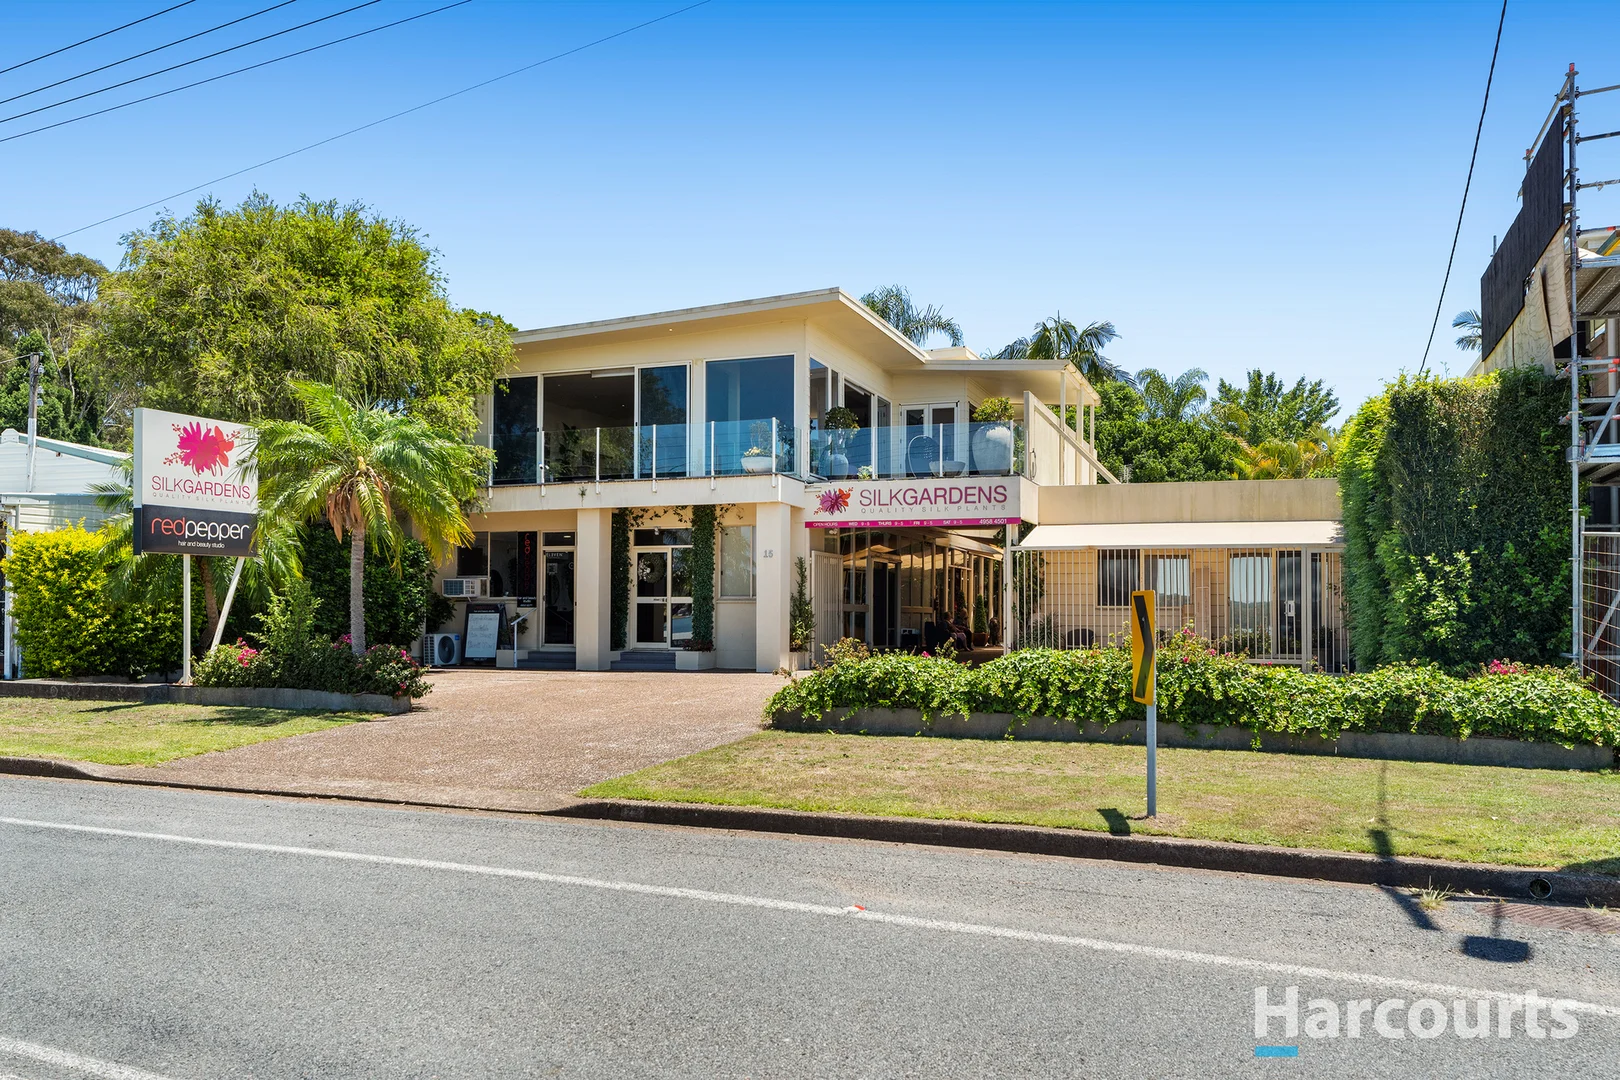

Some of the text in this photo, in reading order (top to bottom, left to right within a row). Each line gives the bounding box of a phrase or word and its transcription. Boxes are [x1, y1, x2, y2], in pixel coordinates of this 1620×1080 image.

[151, 475, 251, 500] SILKGARDENS
[152, 492, 192, 501] QUALITY
[219, 498, 250, 506] PLANTS
[859, 485, 1008, 508] SILKGARDENS
[860, 507, 914, 515] QUALITY
[957, 504, 1007, 512] PLANTS
[151, 516, 250, 541] redpepper
[196, 541, 212, 549] beauty
[763, 549, 774, 558] 15
